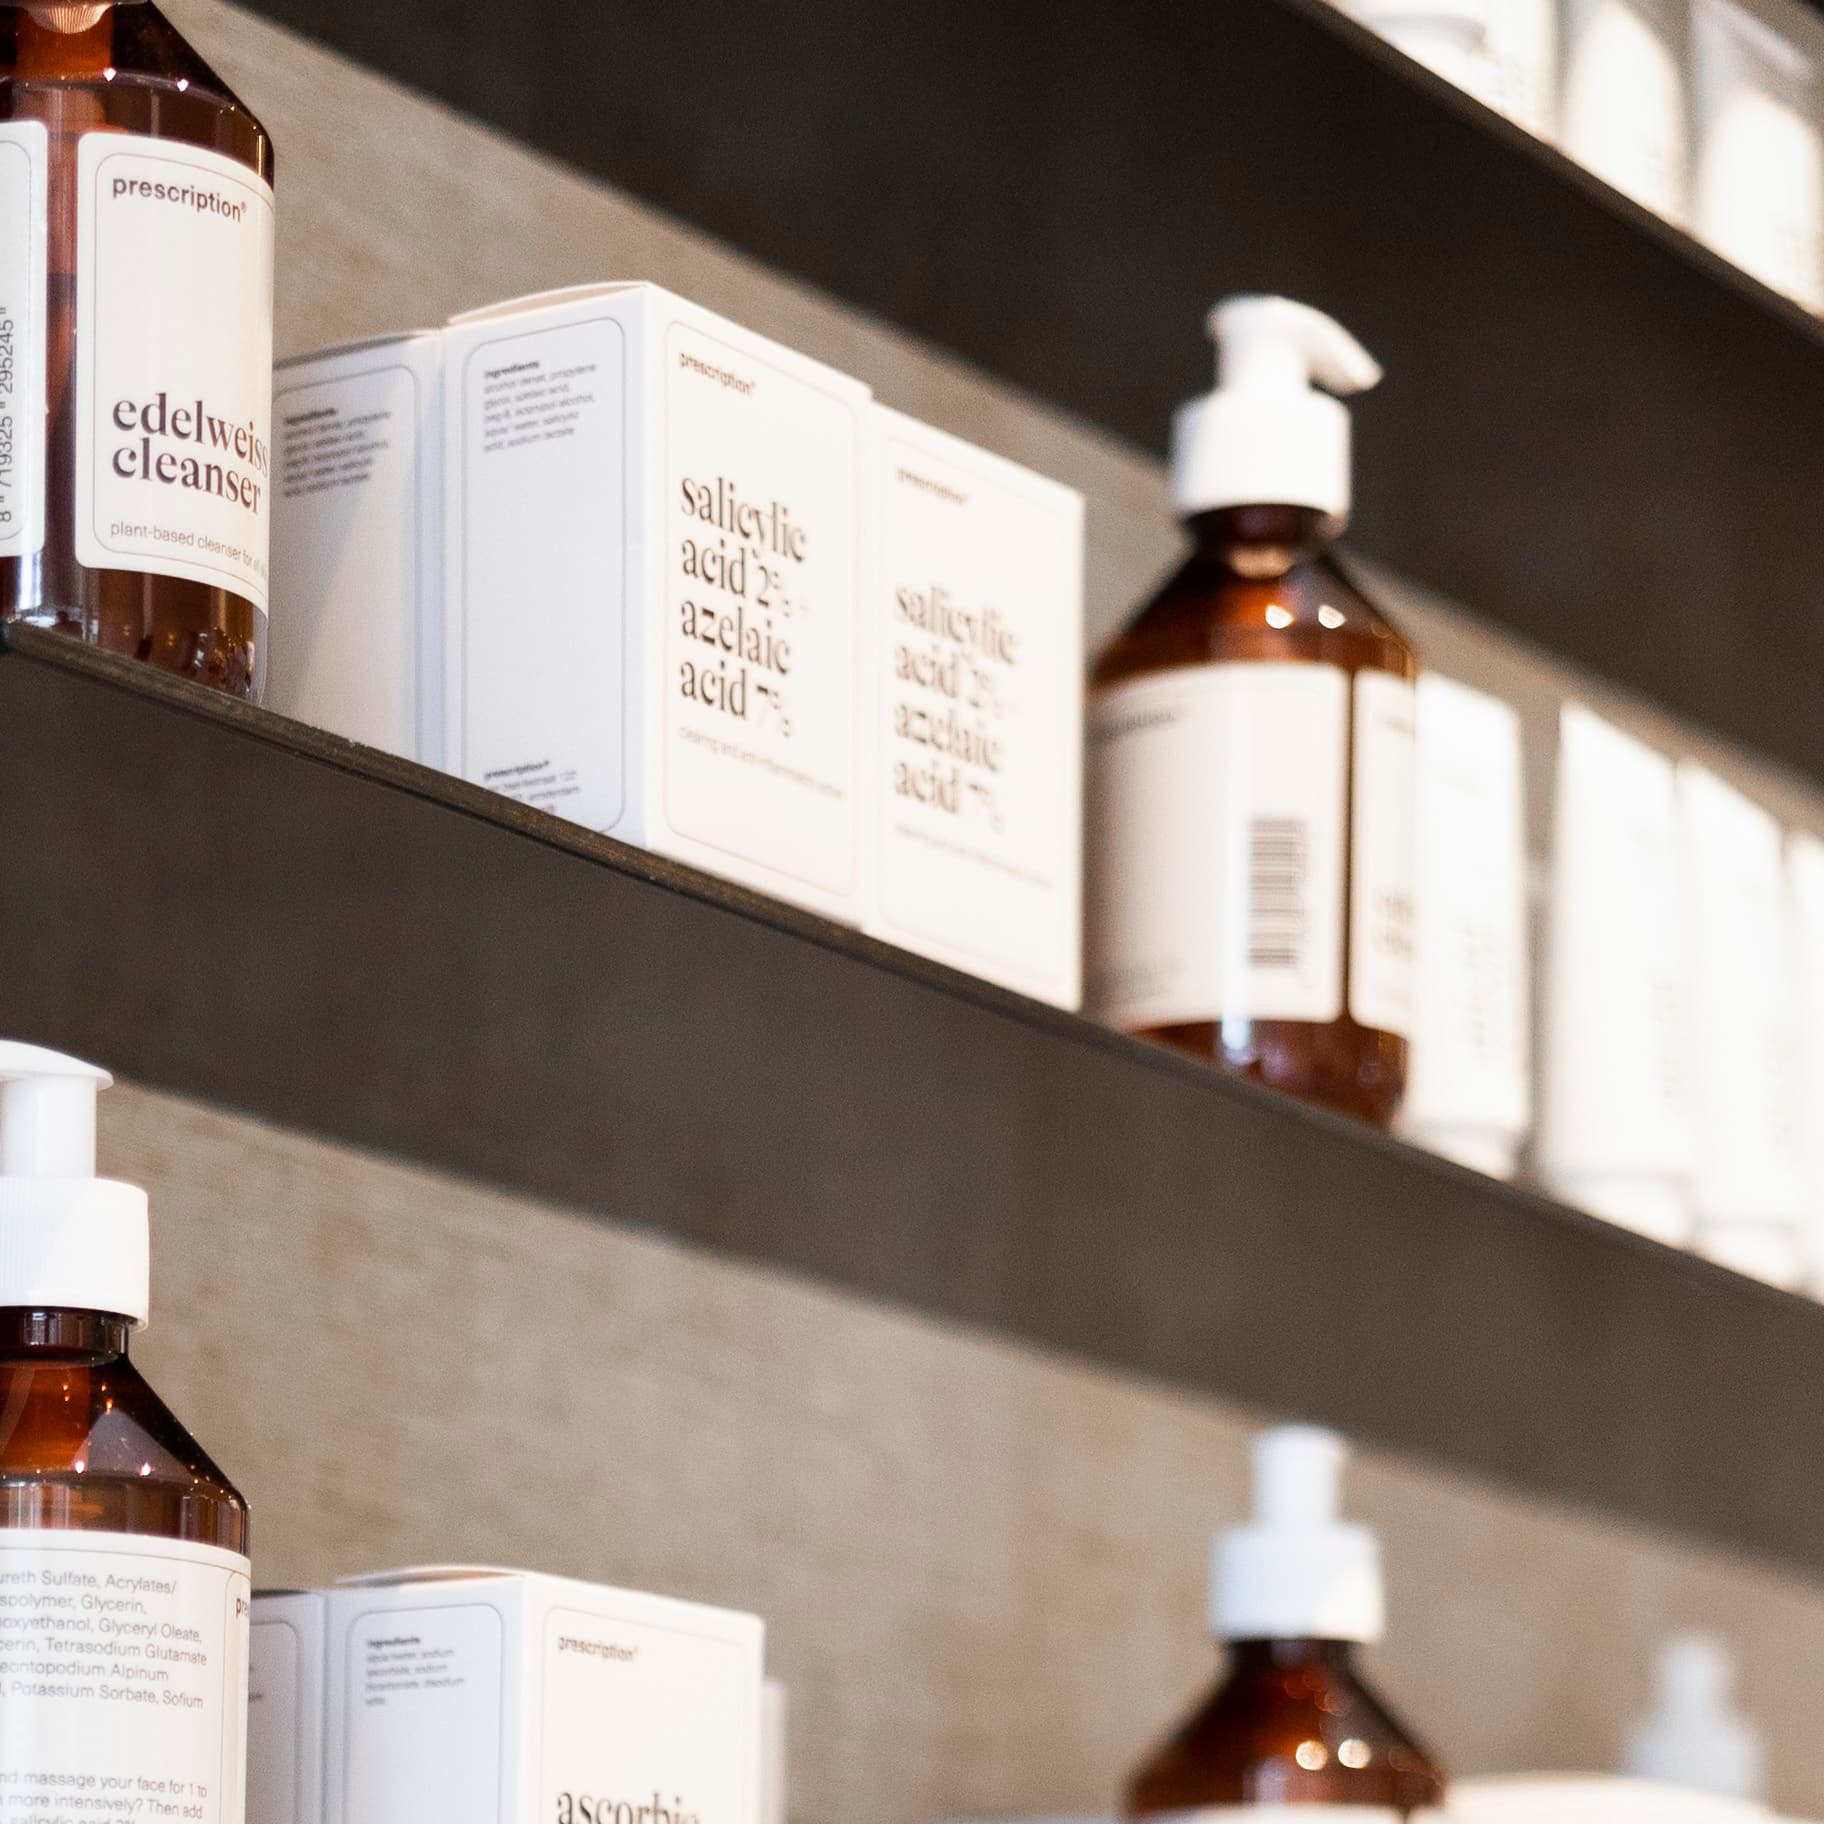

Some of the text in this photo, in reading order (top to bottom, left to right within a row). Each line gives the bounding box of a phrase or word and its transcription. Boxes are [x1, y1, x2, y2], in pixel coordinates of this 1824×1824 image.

[112, 437, 263, 515] cleanser
[110, 521, 194, 548] plant-based
[681, 476, 806, 563] salicylic
[681, 538, 746, 598] acid
[681, 599, 790, 676] azelaic
[681, 659, 747, 720] acid
